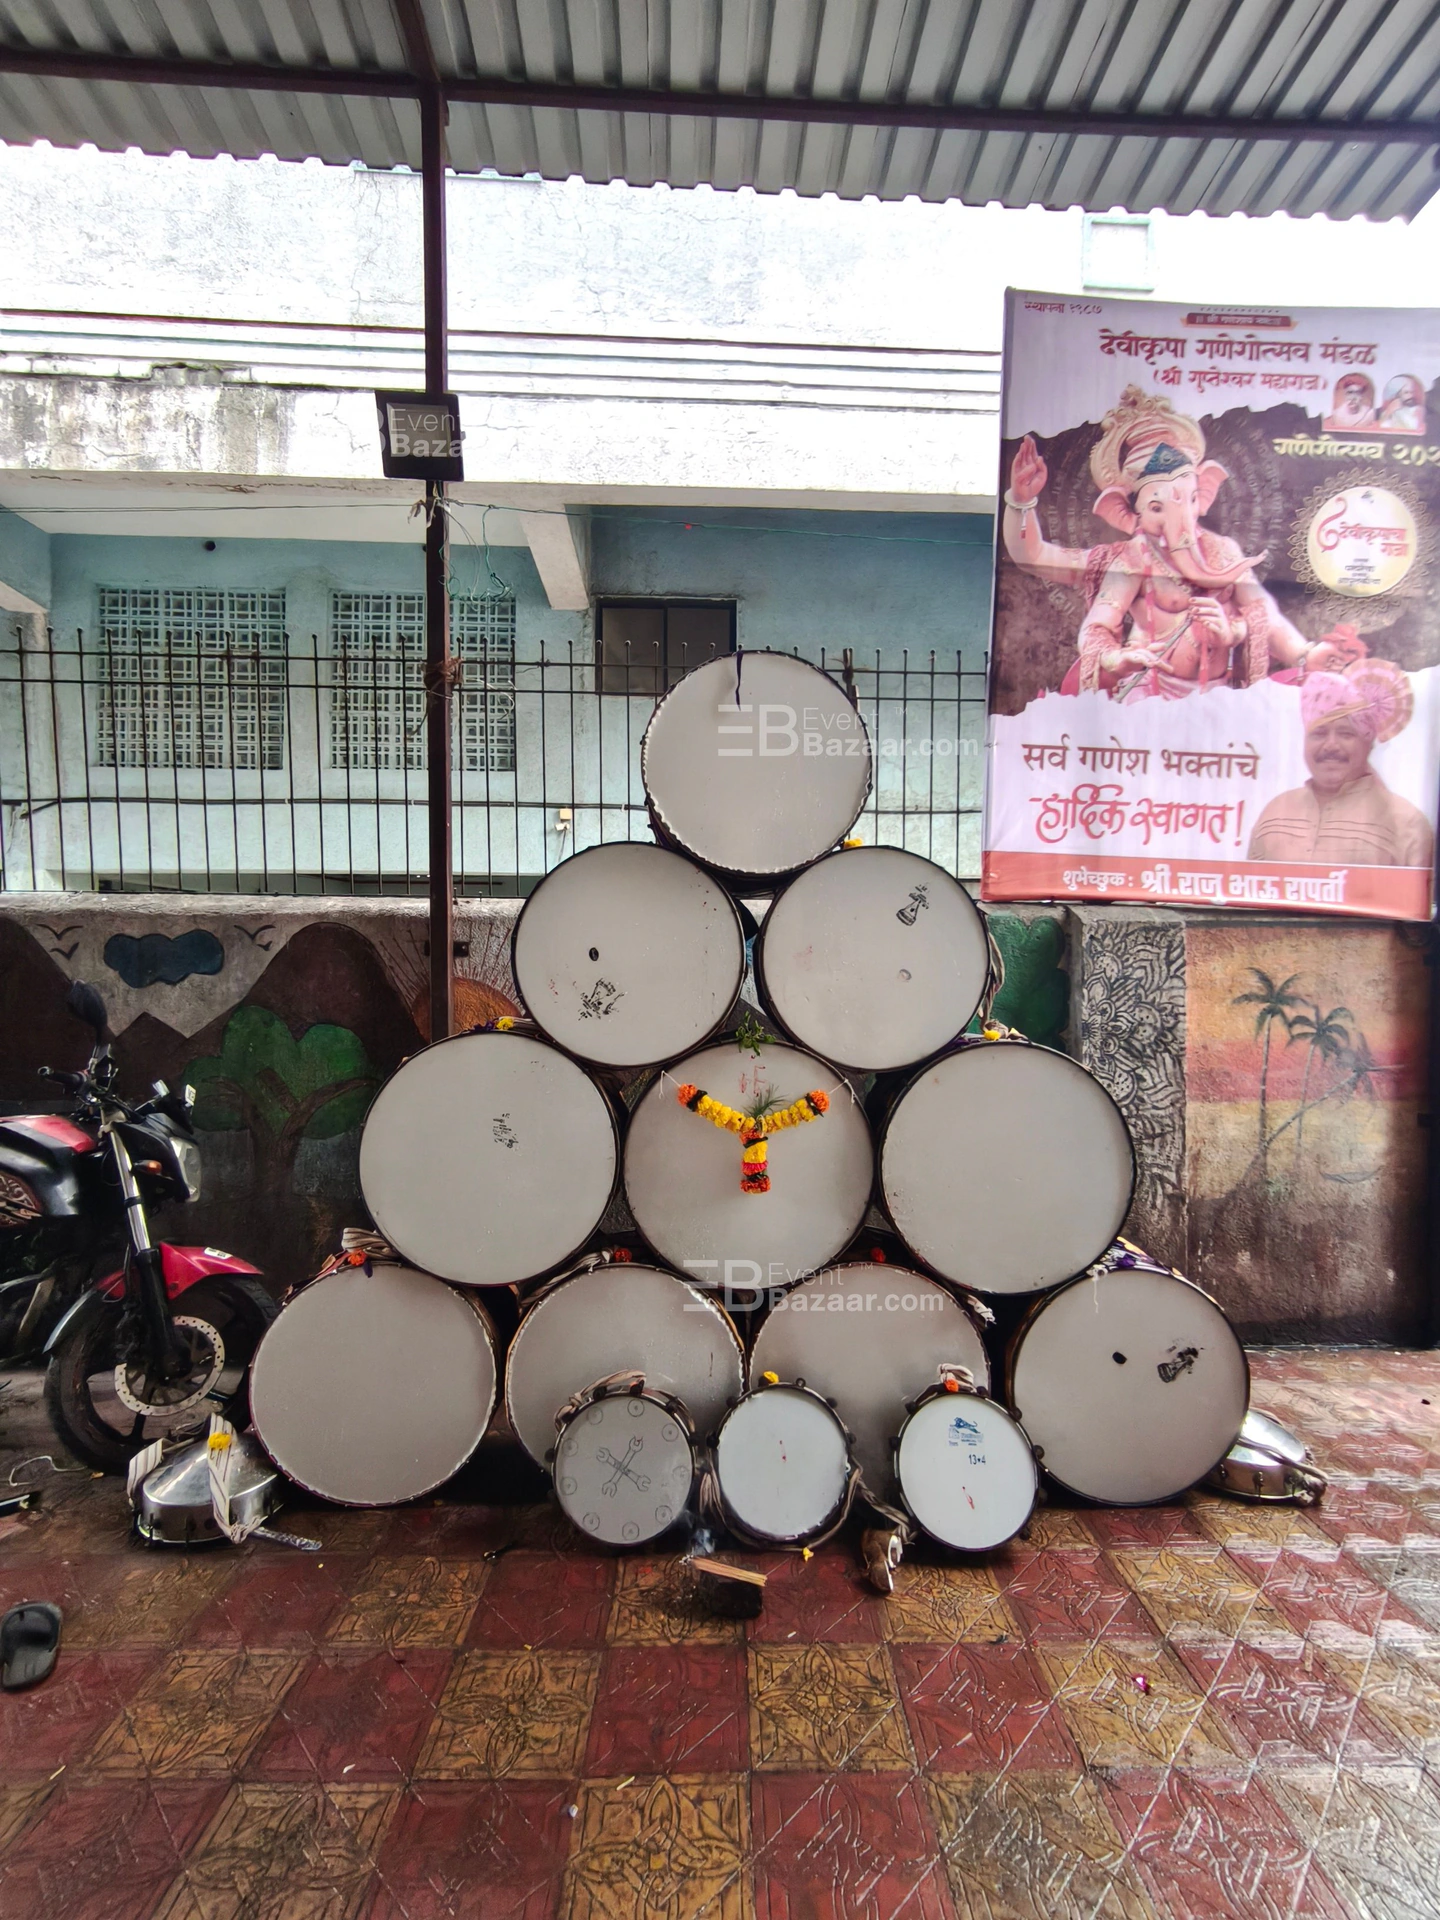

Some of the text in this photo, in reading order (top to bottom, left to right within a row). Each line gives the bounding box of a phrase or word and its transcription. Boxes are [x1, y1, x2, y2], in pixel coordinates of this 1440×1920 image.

[1099, 328, 1379, 365] देवीकृपा गणेशोत्सव मंडळ
[1391, 443, 1440, 466] २०२
[1021, 733, 1261, 780] सर्व गणेश भक्तांचे
[1028, 783, 1132, 844] हार्दिक
[1229, 874, 1280, 901] भाऊ
[1284, 869, 1349, 903] रापर्ती
